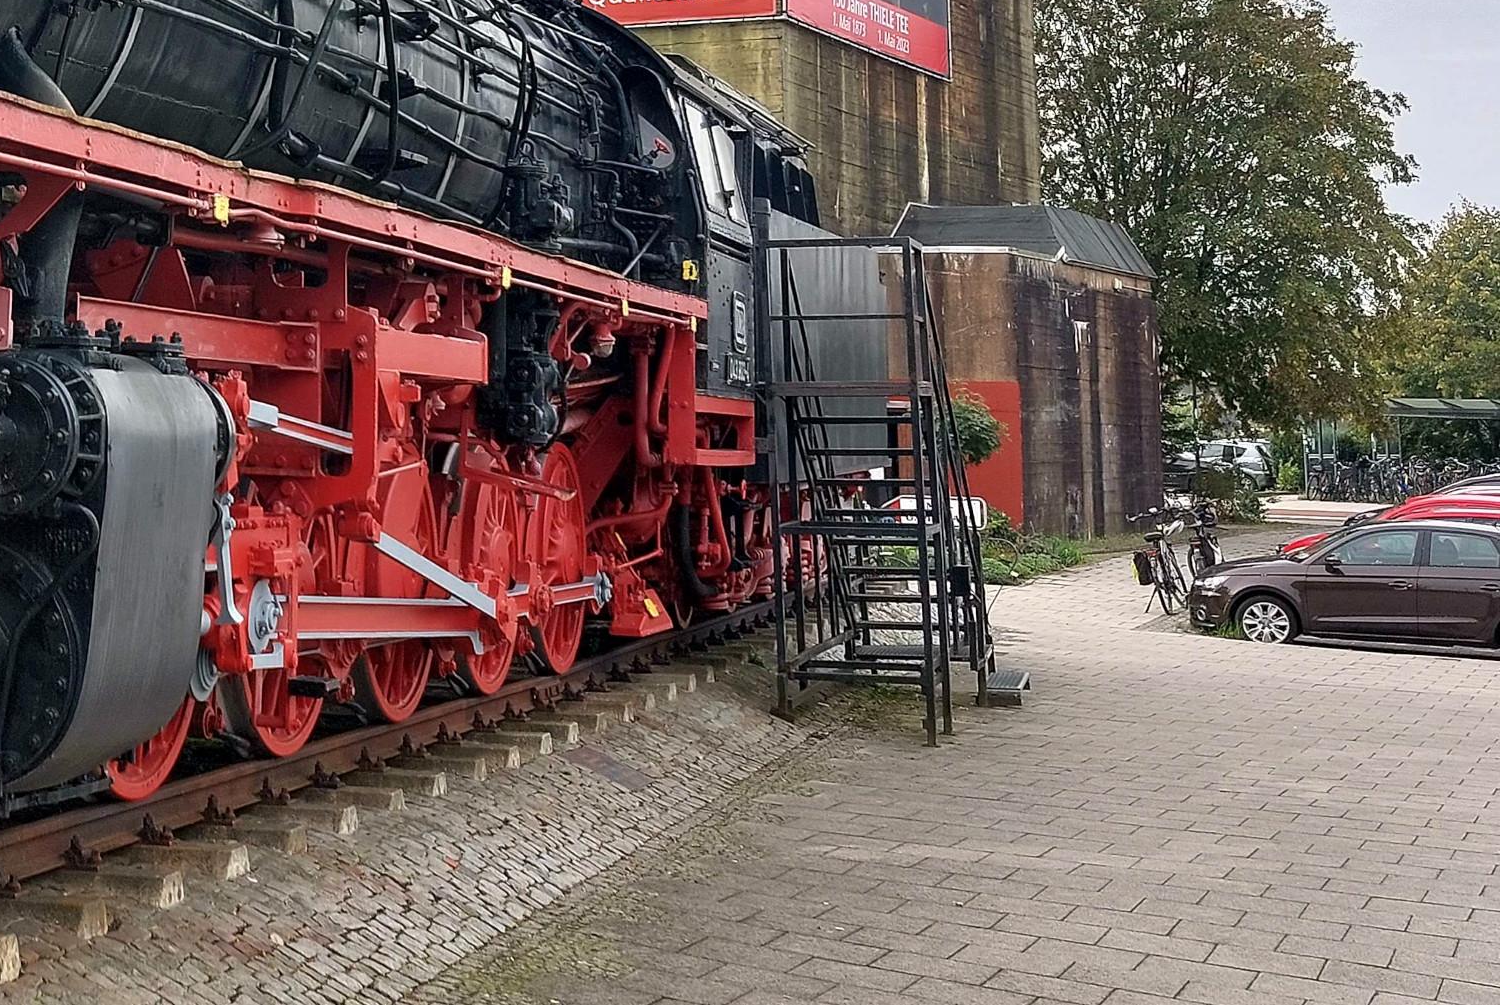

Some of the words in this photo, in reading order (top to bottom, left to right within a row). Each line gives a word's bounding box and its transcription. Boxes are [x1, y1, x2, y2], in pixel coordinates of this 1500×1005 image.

[839, 13, 852, 32] Mai
[869, 1, 894, 30] THIELE
[895, 12, 909, 35] TEE
[884, 31, 896, 49] Mai
